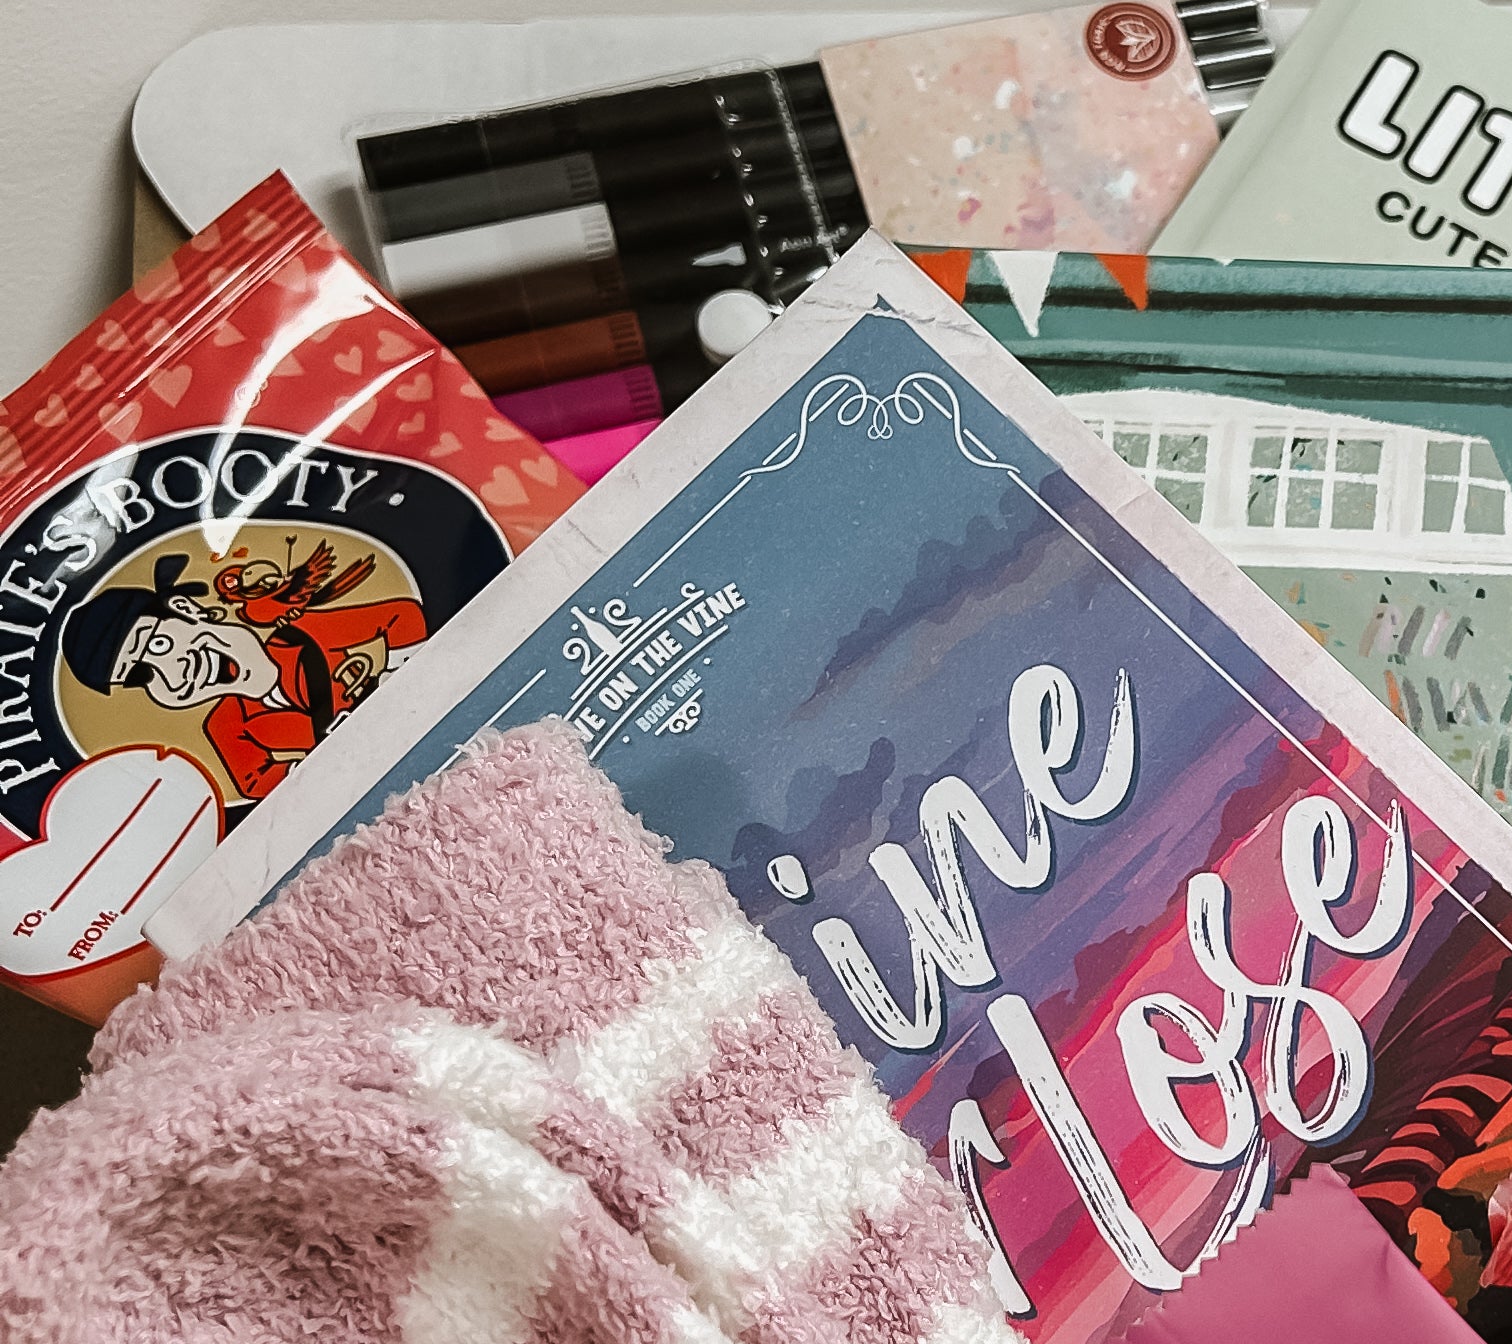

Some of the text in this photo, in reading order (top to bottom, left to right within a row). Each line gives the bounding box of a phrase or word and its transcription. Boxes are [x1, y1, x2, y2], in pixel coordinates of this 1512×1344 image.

[1376, 191, 1508, 269] CUTE
[105, 449, 378, 534] BOOTY
[599, 671, 639, 711] ON
[629, 629, 684, 676] THE
[677, 582, 746, 637] VINE
[635, 668, 702, 732] BOOK ONE
[13, 910, 47, 937] TO:
[68, 910, 119, 961] FROM:
